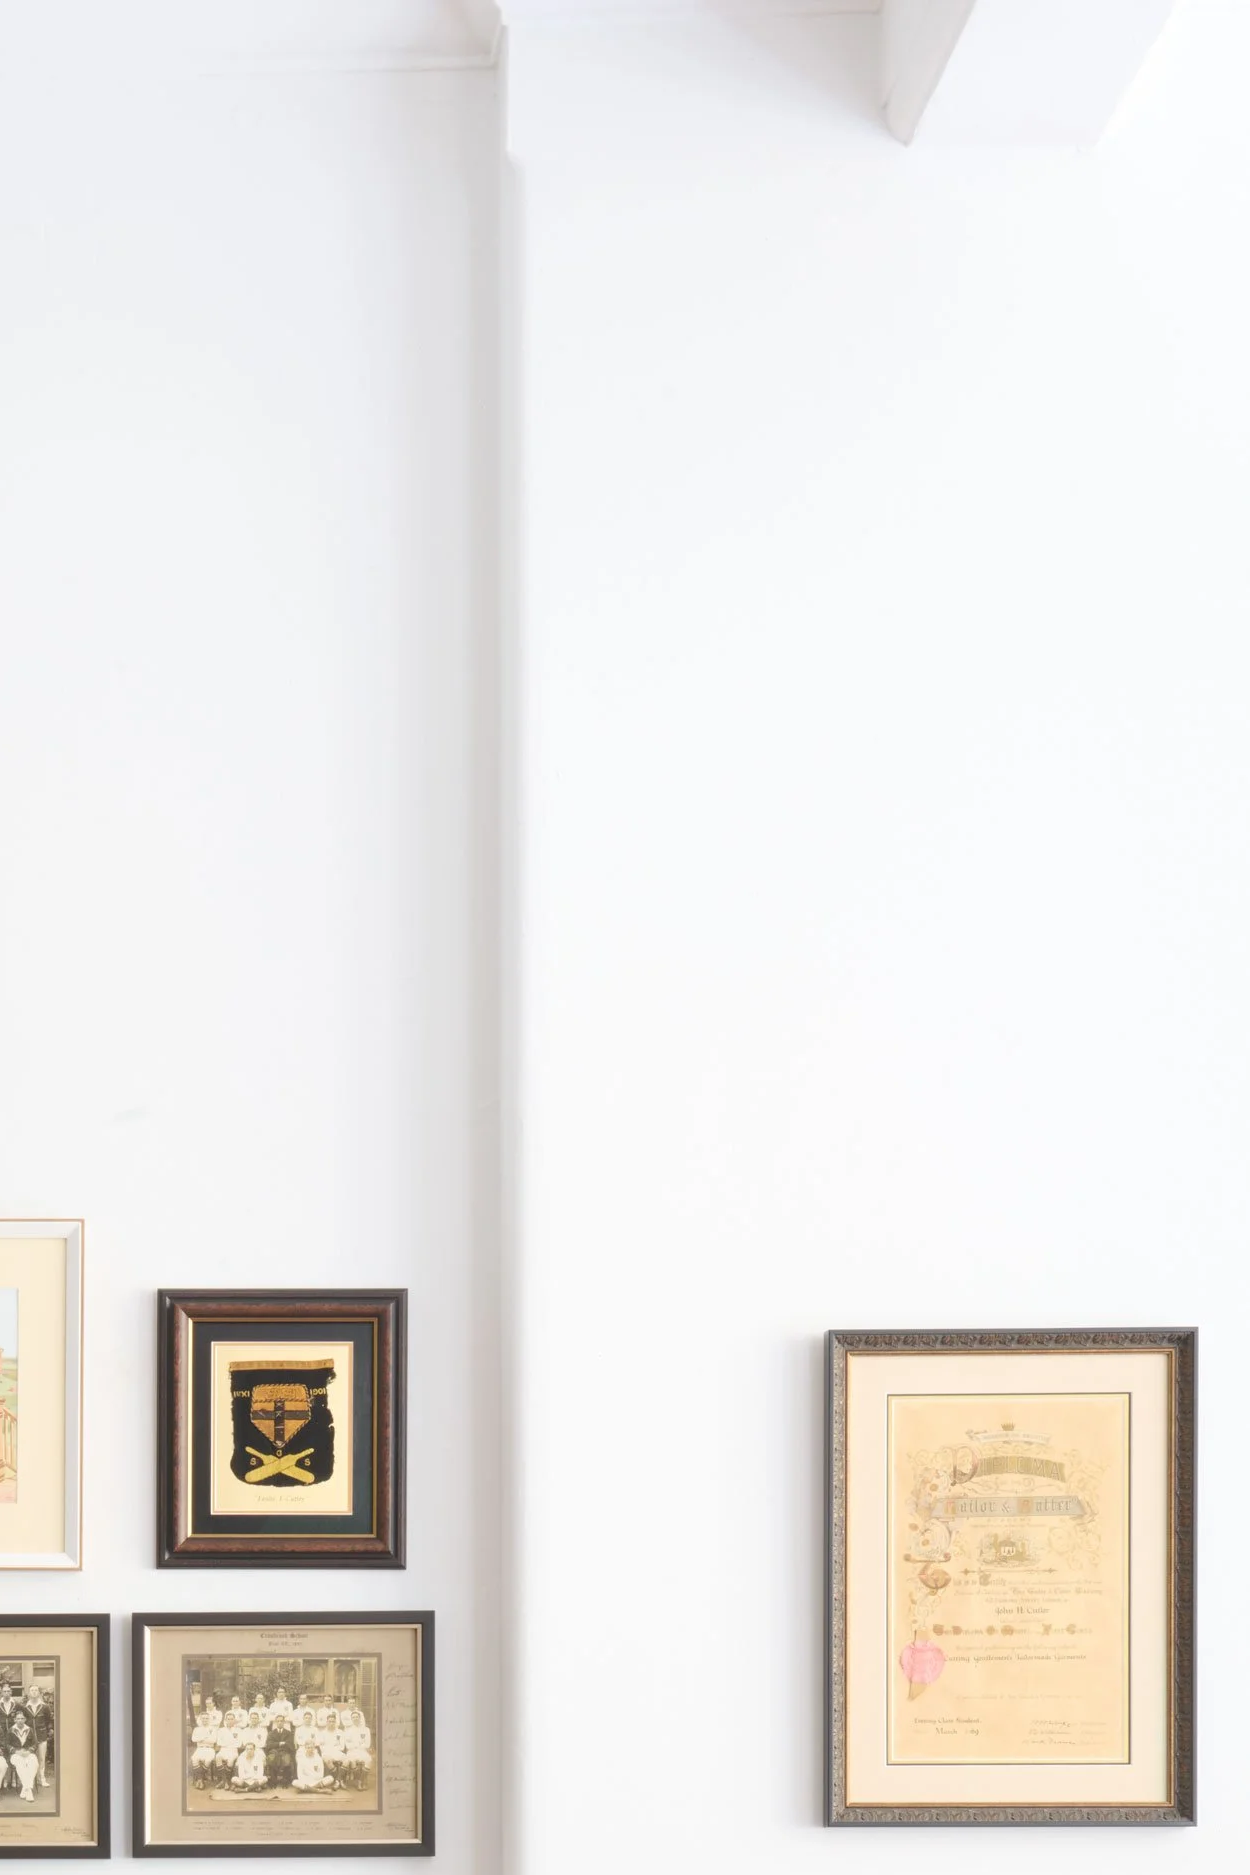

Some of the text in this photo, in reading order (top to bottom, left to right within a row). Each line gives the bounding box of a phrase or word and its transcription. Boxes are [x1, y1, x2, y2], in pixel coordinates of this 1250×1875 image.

[249, 1457, 257, 1466] S
[304, 1458, 311, 1466] S
[1000, 1502, 1012, 1514] &
